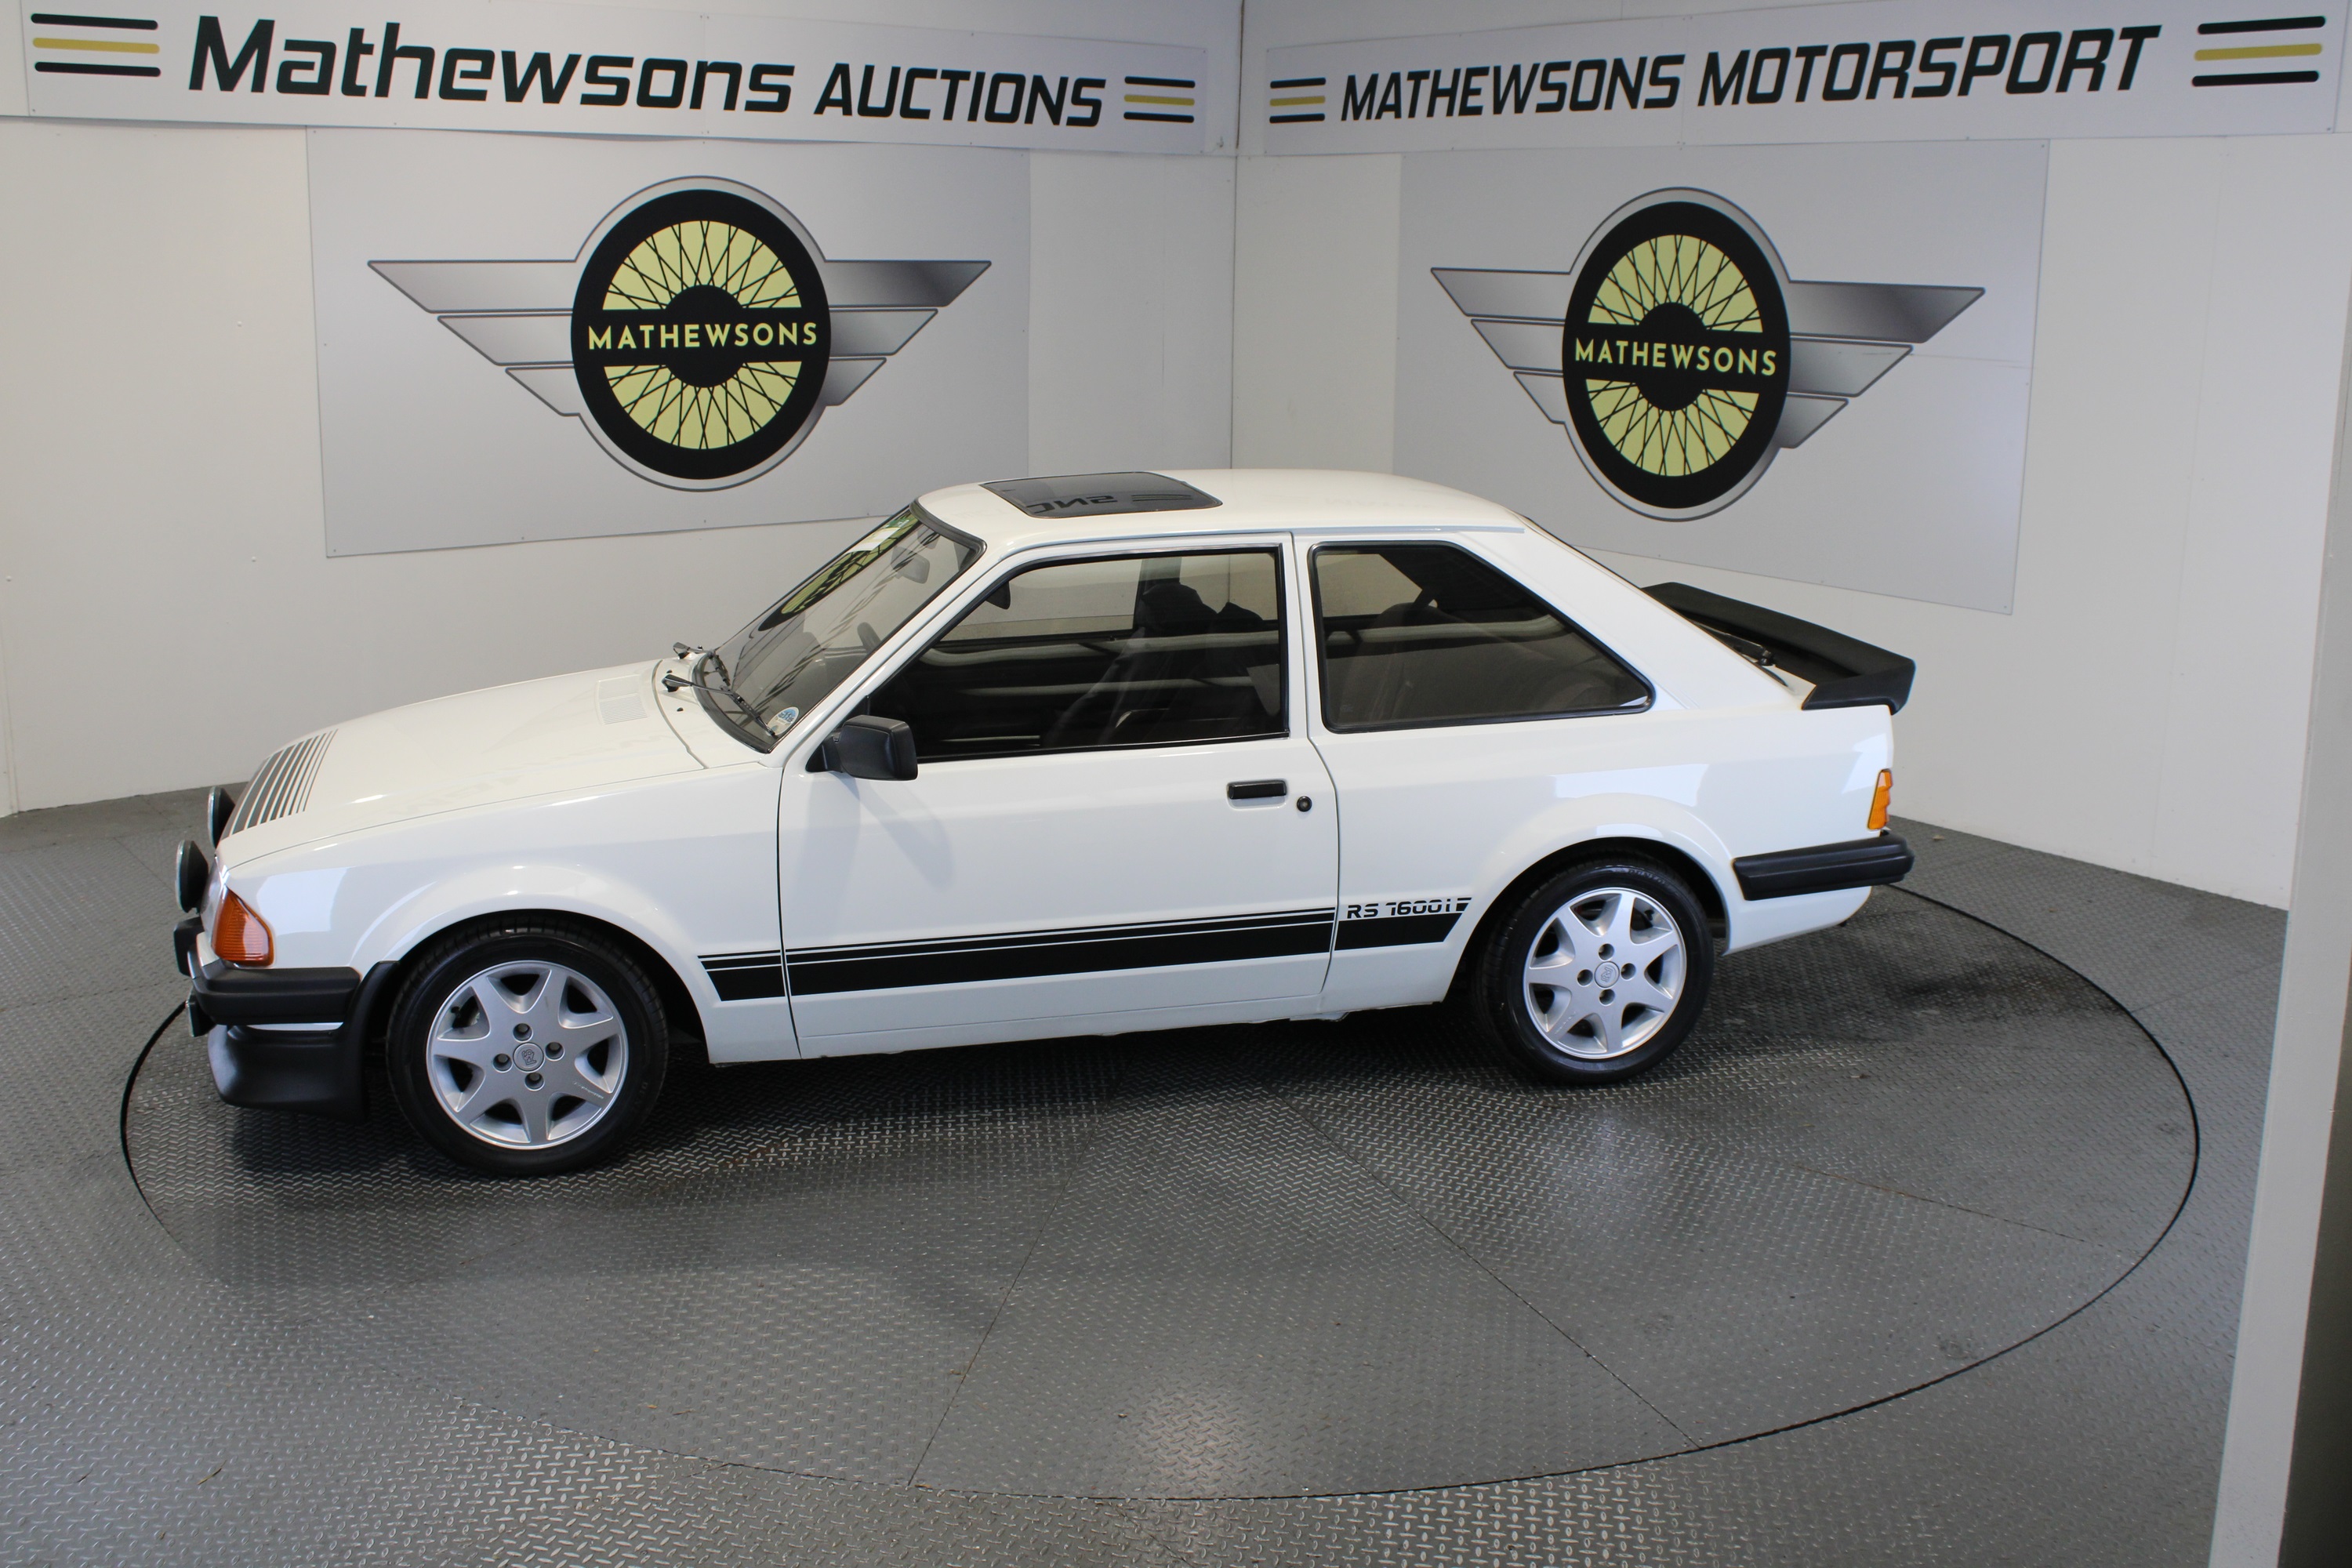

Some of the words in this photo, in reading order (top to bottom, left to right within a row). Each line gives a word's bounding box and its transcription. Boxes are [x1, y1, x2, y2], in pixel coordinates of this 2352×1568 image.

[188, 16, 795, 113] Mathewsons
[813, 63, 1107, 128] AUCTIONS
[1341, 54, 1686, 122] MATHEWSONS
[1697, 24, 2162, 107] MOTORSPORT
[588, 321, 817, 350] MATHEWSONS
[1574, 337, 1777, 376] MATHEWSONS
[1346, 902, 1379, 919] RS
